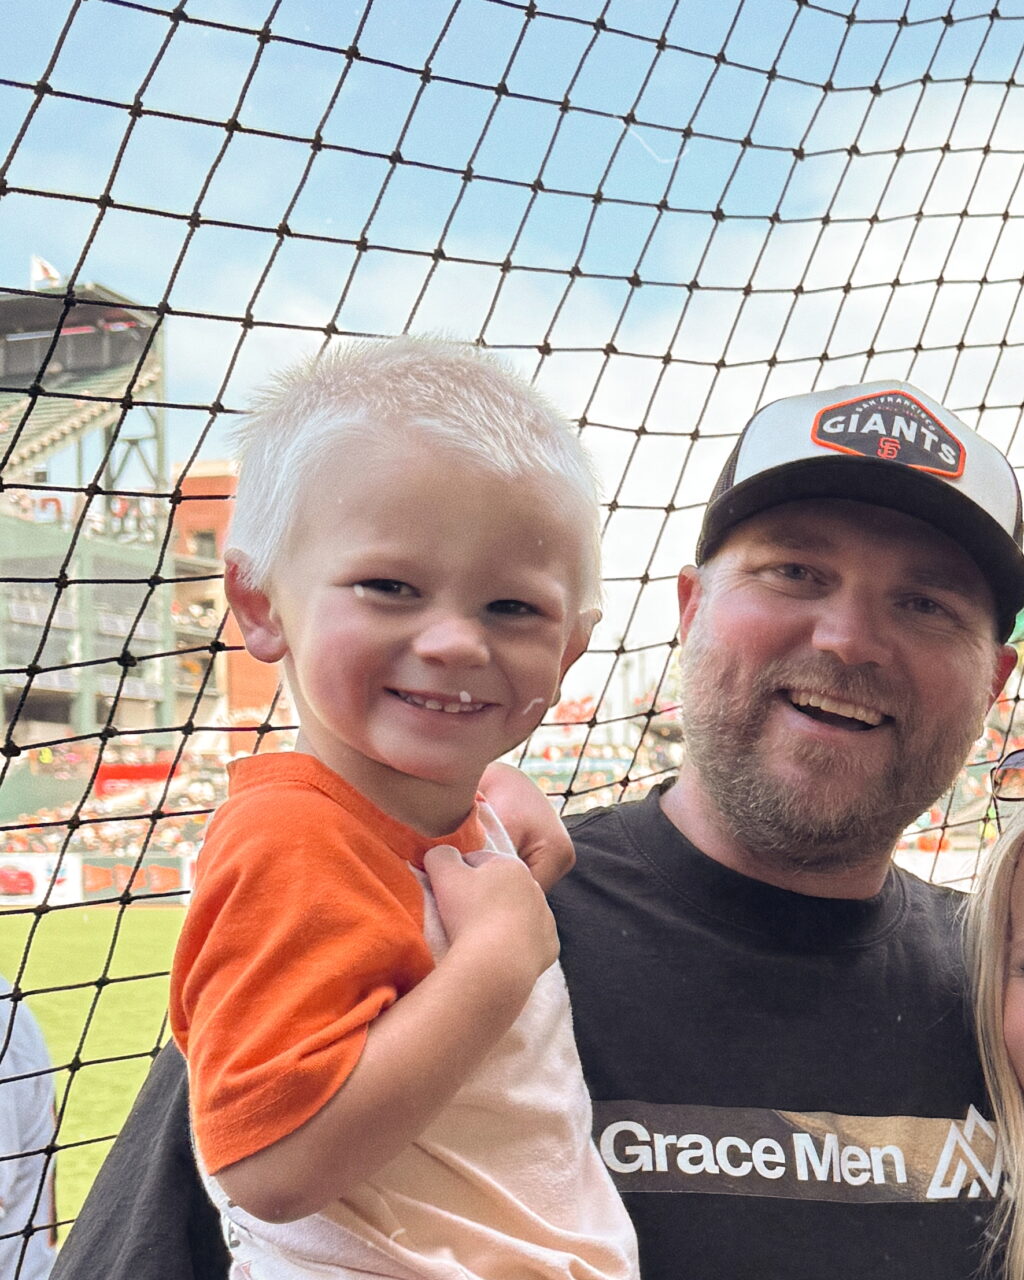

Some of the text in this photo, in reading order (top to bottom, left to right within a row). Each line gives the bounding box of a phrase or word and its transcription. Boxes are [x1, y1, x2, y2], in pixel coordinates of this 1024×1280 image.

[821, 412, 957, 466] GIANTS
[599, 1119, 908, 1187] Grace Men
